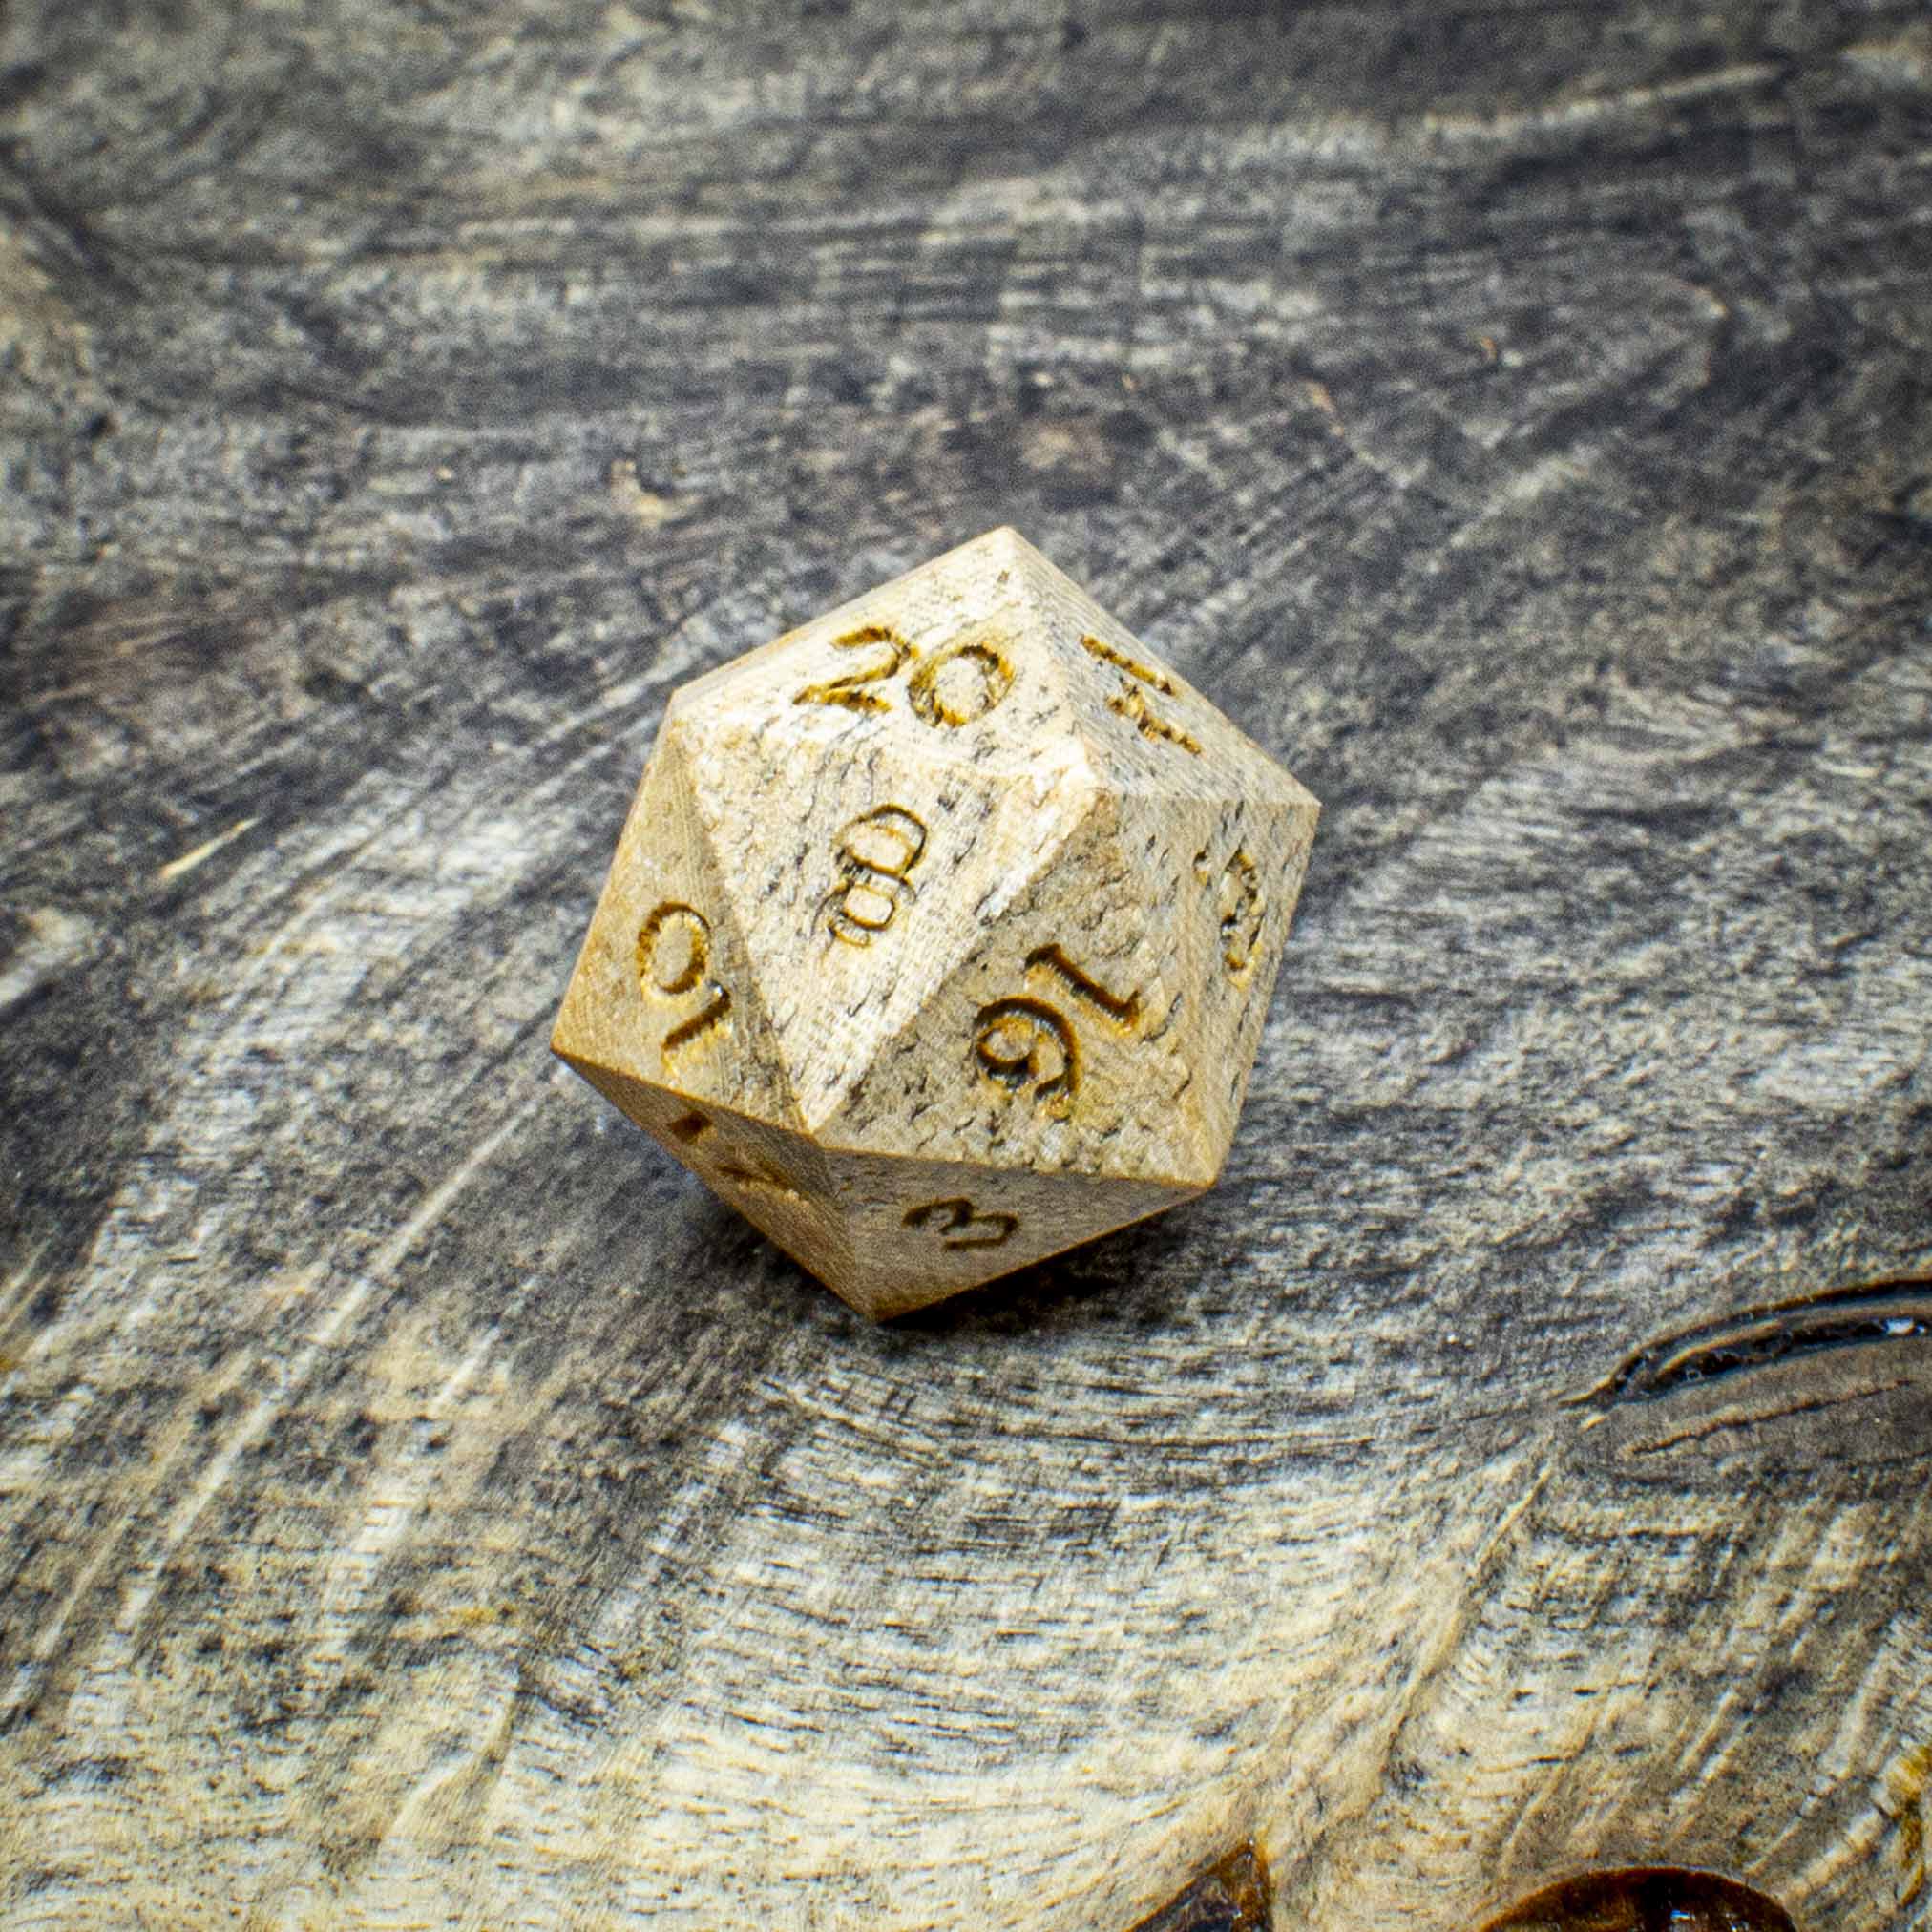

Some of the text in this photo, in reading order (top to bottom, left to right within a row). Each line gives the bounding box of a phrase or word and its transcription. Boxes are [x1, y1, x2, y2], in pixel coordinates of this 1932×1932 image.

[792, 626, 1015, 728] 20
[831, 804, 927, 947] 8
[637, 901, 731, 1065] 10
[975, 943, 1140, 1117] 16
[901, 1197, 1019, 1250] 3
